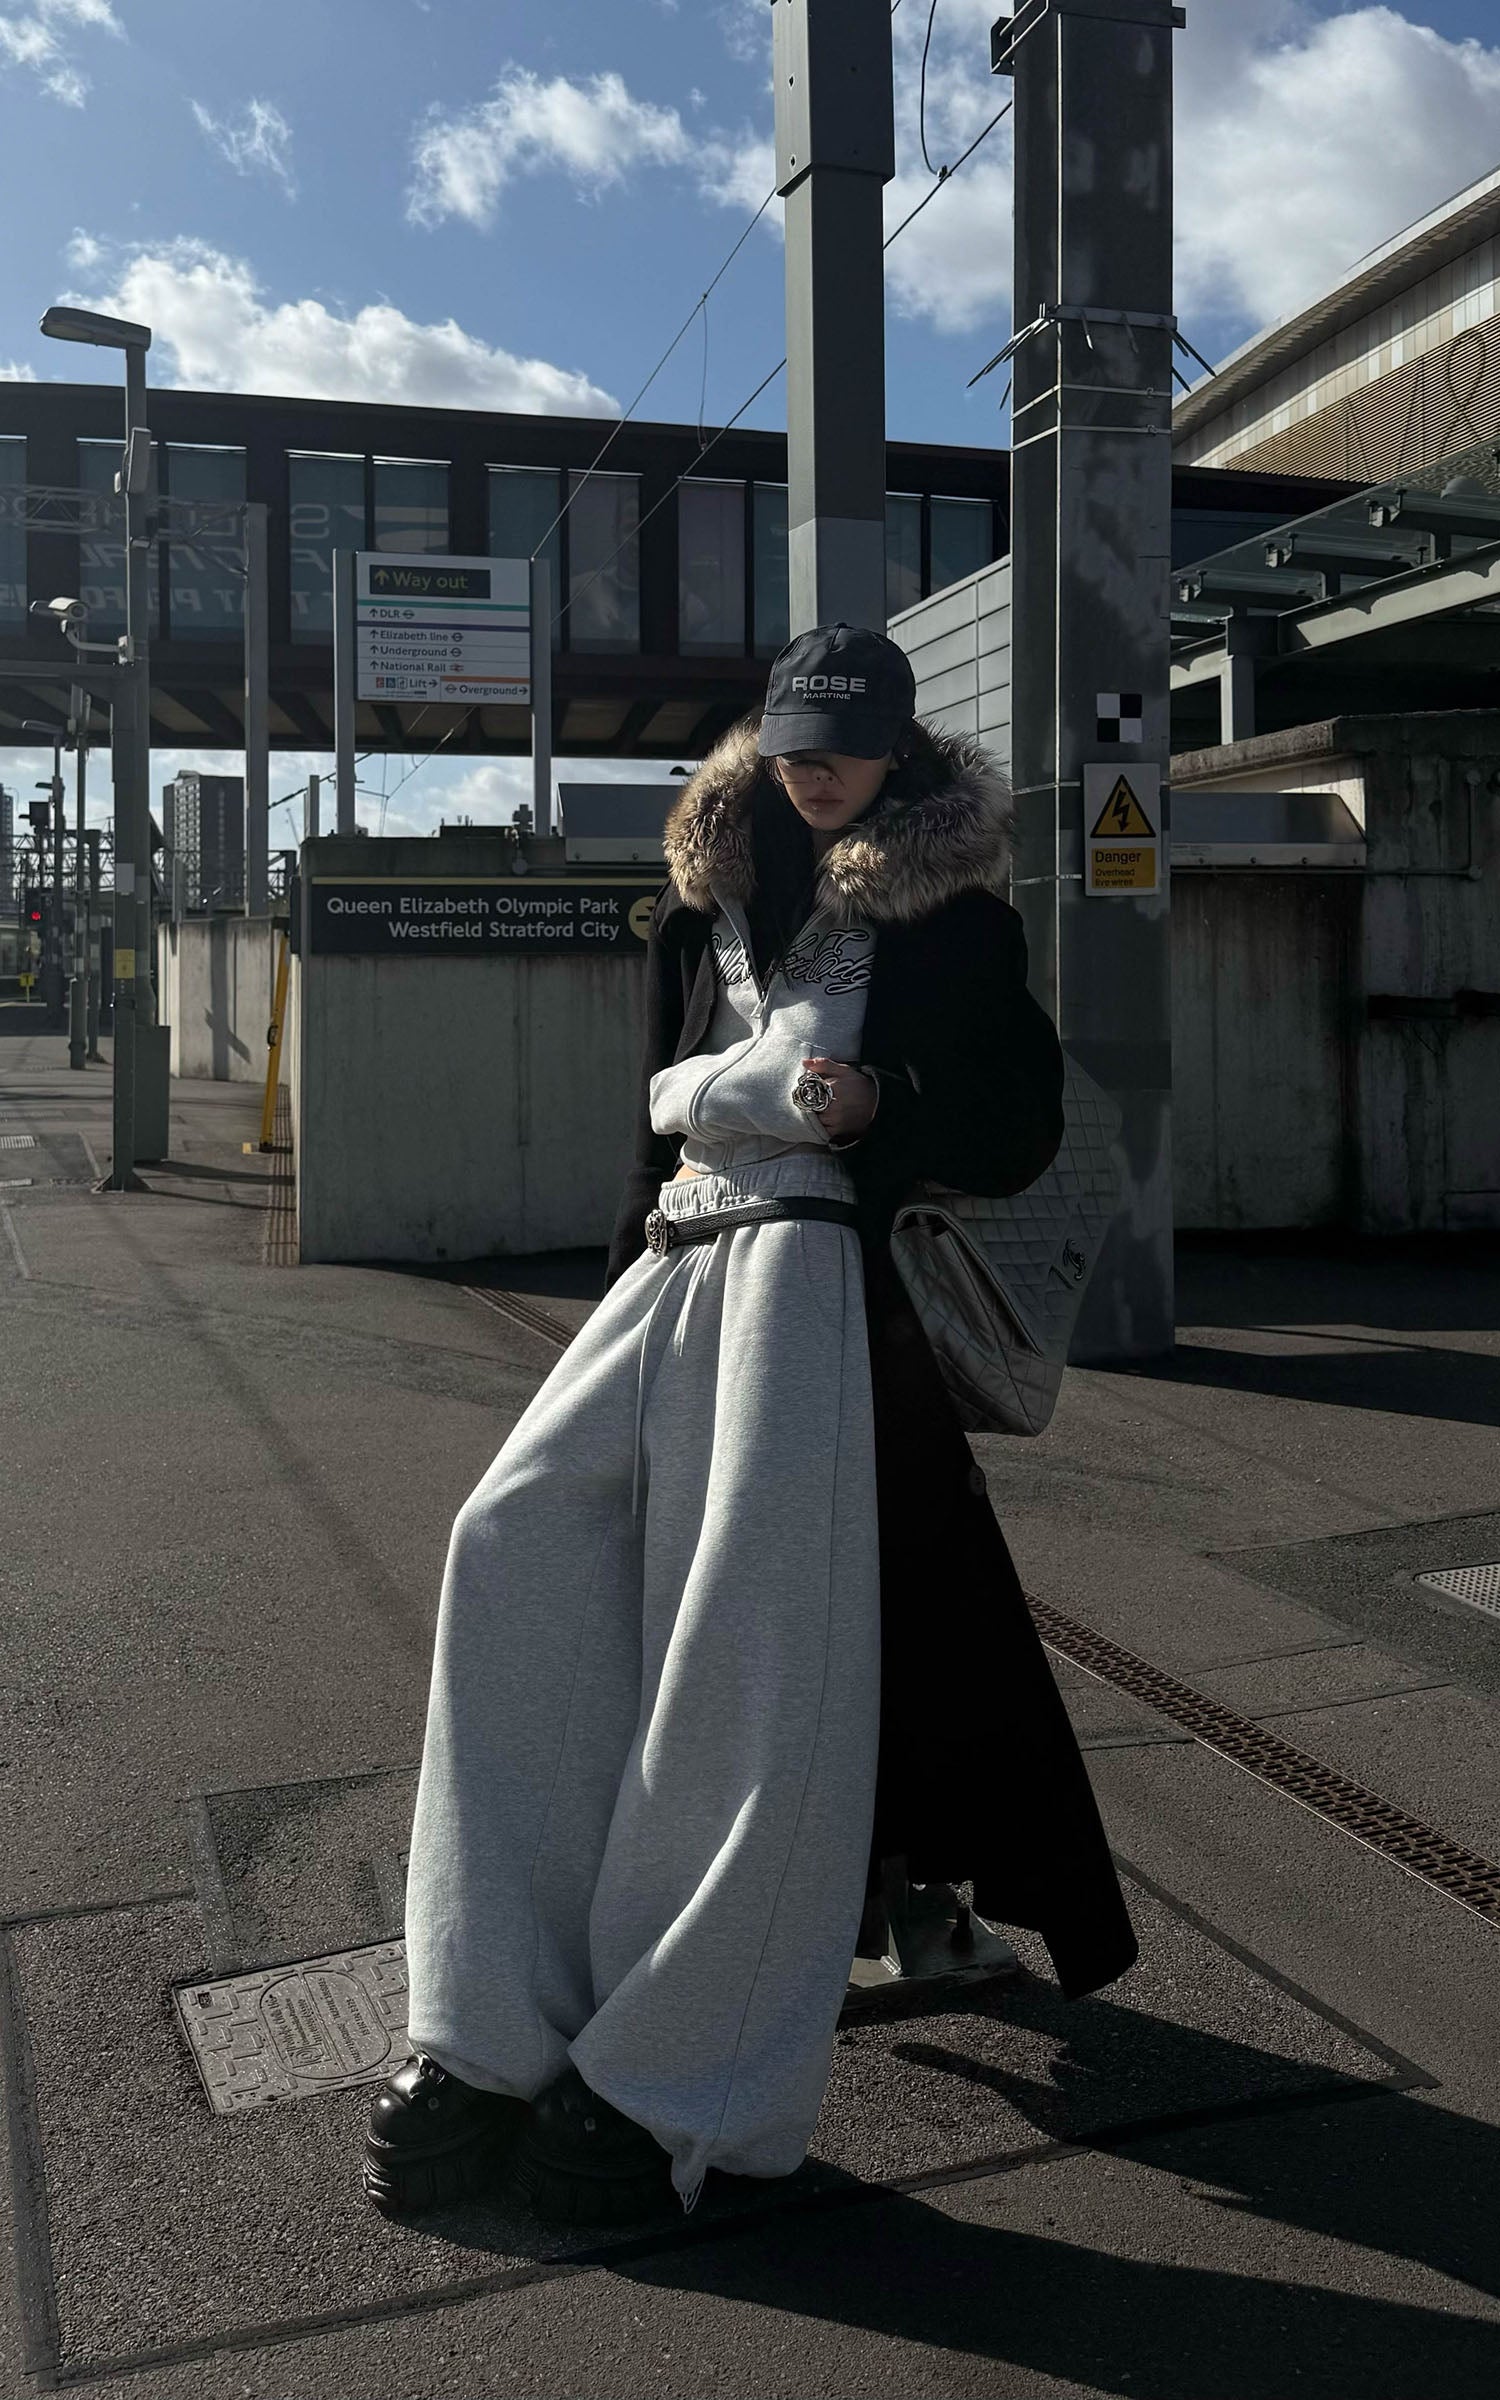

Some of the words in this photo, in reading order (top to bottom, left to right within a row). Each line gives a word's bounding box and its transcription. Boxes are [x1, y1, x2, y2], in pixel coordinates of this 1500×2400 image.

[393, 571, 431, 591] Way
[436, 574, 469, 589] out
[379, 608, 400, 619] DLR
[379, 630, 427, 641] Elizabeth
[430, 631, 448, 642] line
[380, 646, 447, 658] Underground
[380, 661, 425, 672] National
[427, 662, 446, 672] Rail
[409, 678, 427, 688] Lift
[459, 685, 518, 696] Overground
[792, 675, 867, 693] ROSE
[1095, 851, 1142, 864] Danger
[1095, 868, 1135, 877] Overhead
[327, 897, 393, 915] Queen
[399, 897, 490, 915] Elizabeth
[496, 897, 574, 919] Olympic
[579, 898, 620, 915] Park
[388, 921, 483, 939] Westfield
[489, 921, 575, 939] Stratford
[580, 921, 620, 941] City
